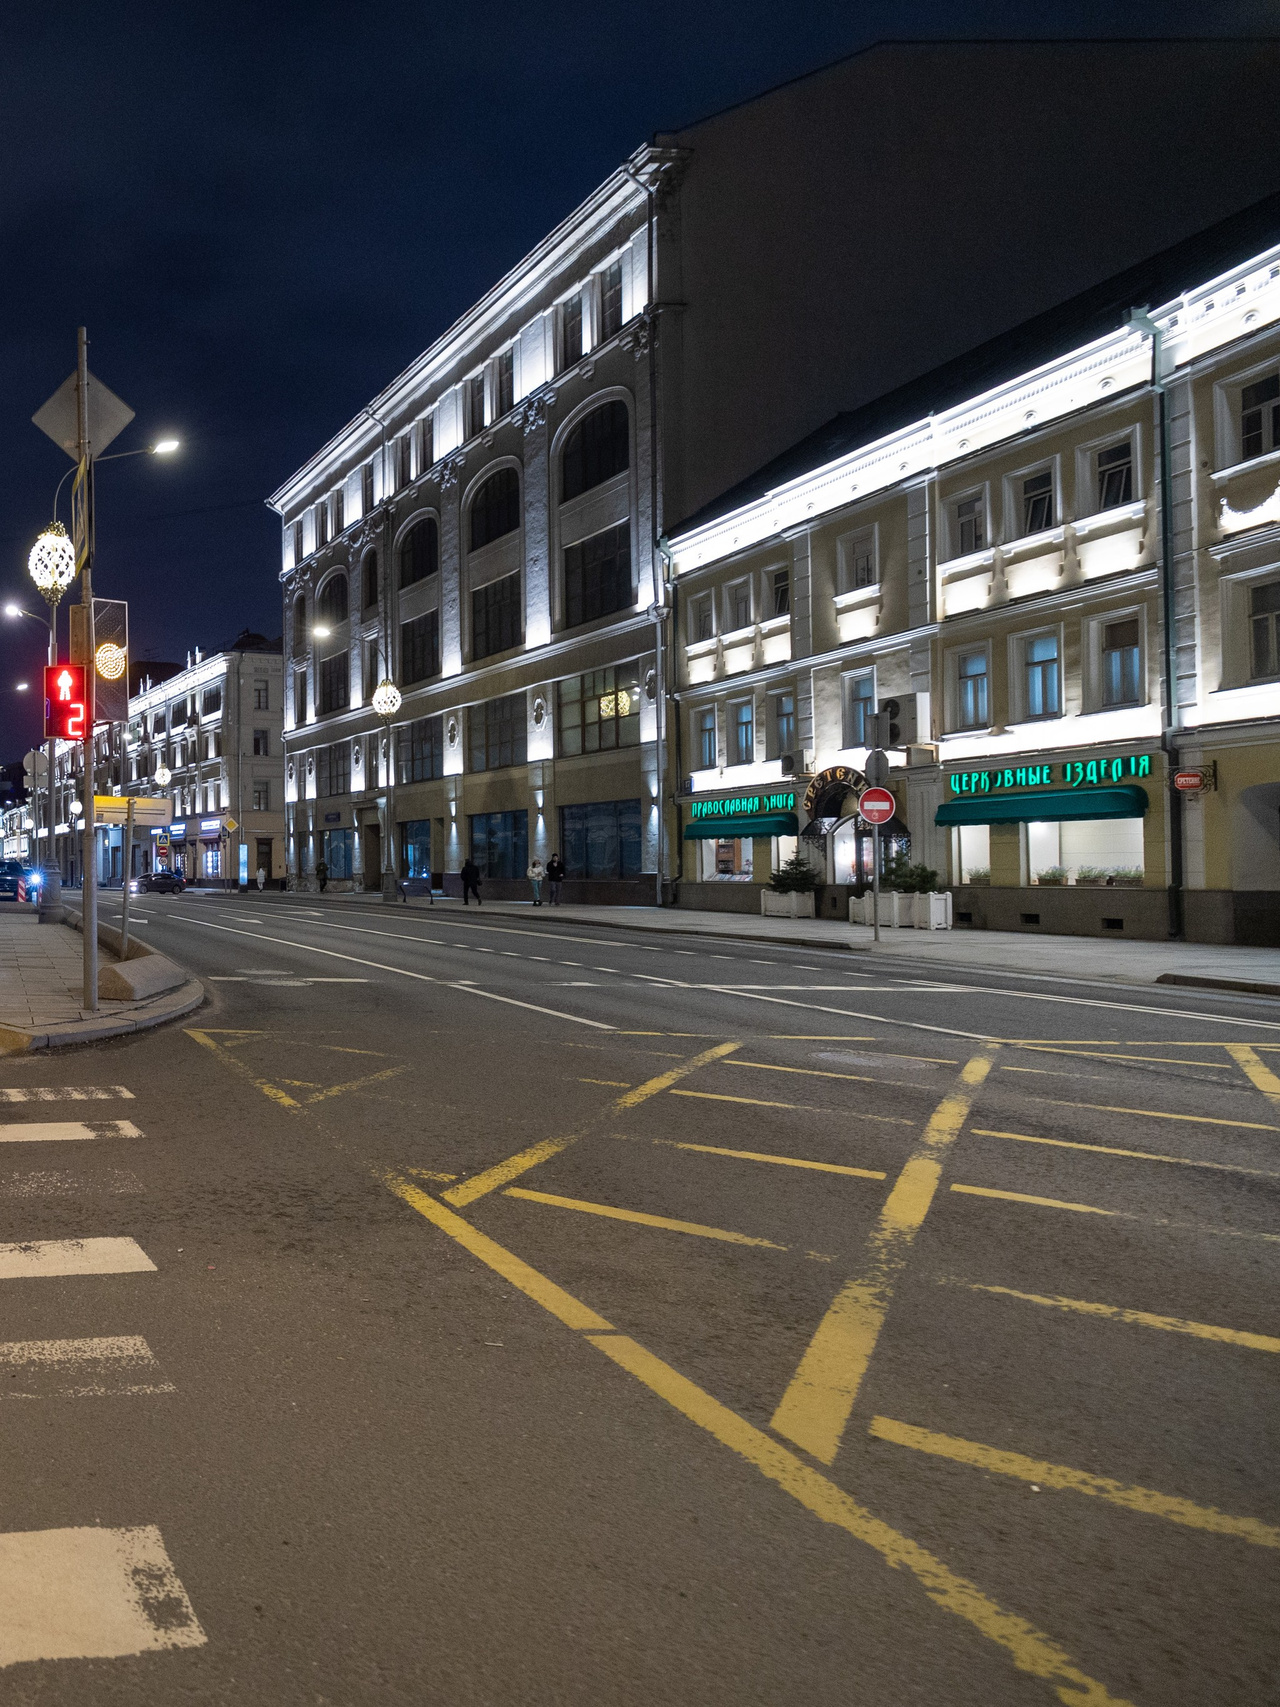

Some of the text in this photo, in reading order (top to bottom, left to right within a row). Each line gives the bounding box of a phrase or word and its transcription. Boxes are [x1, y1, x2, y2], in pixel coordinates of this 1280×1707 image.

[68, 704, 84, 736] 2
[950, 765, 1052, 795] ЦЕРКОВНЫЕ
[691, 792, 795, 818] ПРАВОСЛАВНАЯ КНИГА
